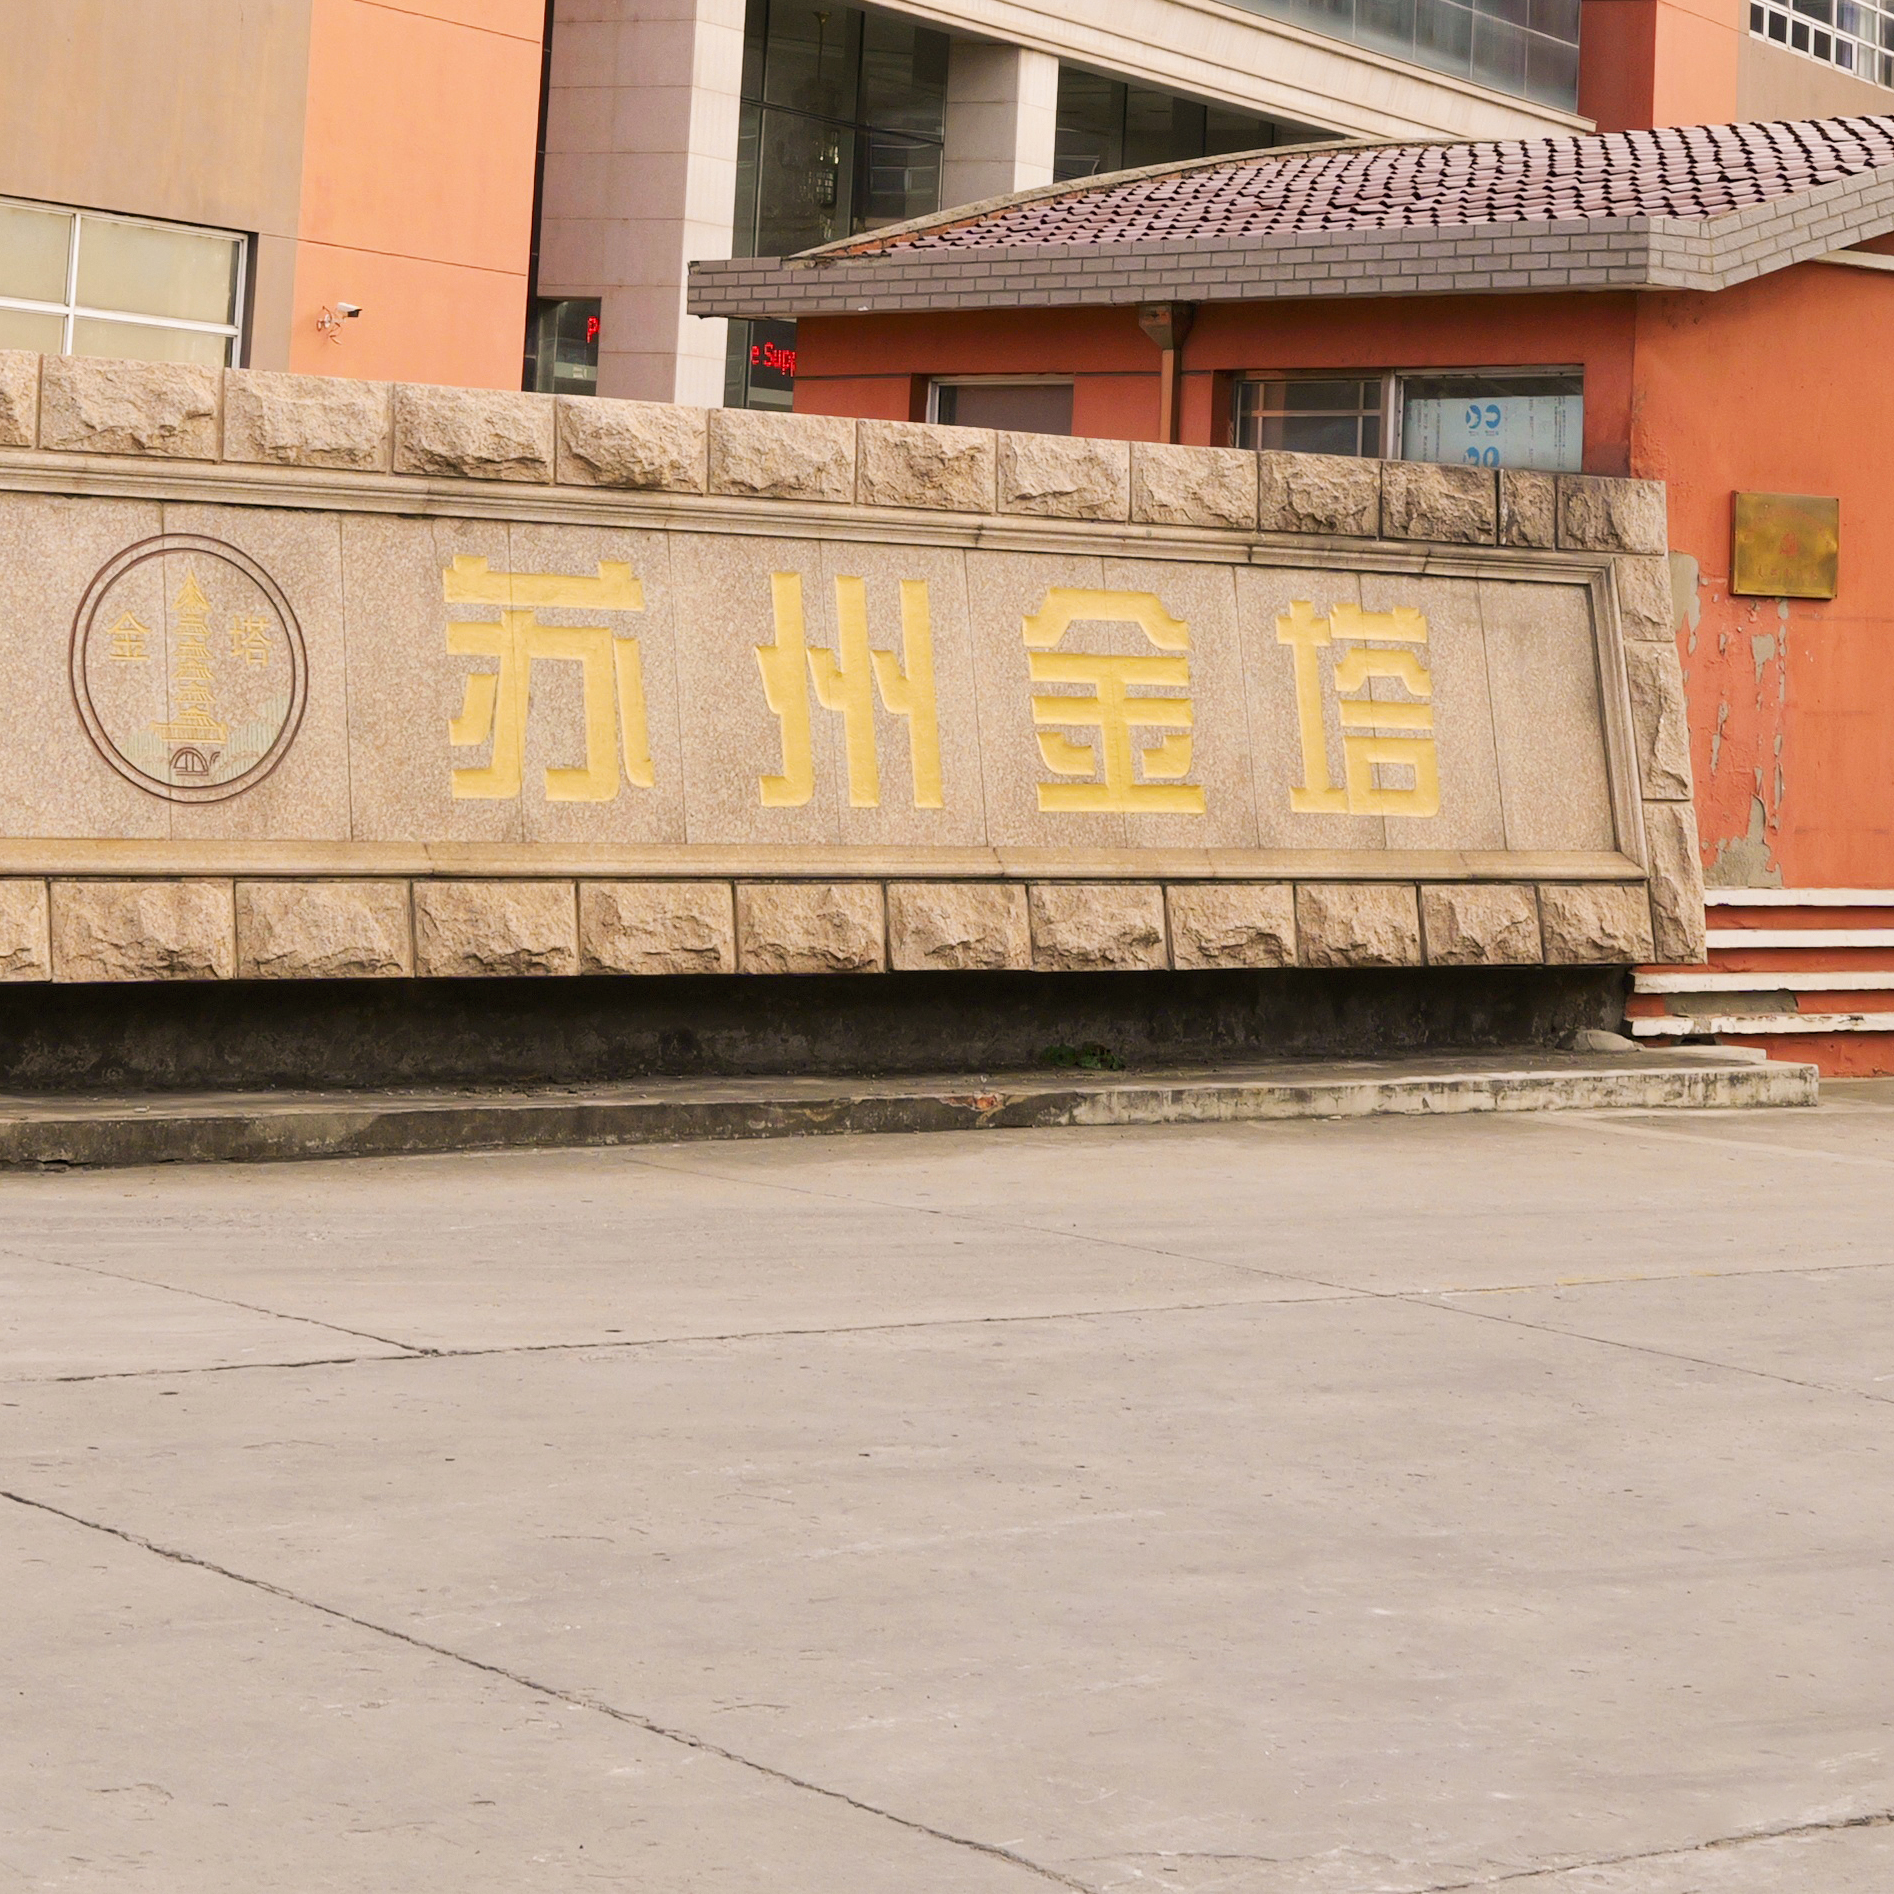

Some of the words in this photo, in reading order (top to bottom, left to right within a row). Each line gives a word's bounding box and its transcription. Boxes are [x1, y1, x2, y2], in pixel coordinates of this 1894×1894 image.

[107, 610, 152, 662] 金
[229, 615, 273, 666] 塔
[442, 553, 1440, 817] 苏州金塔
